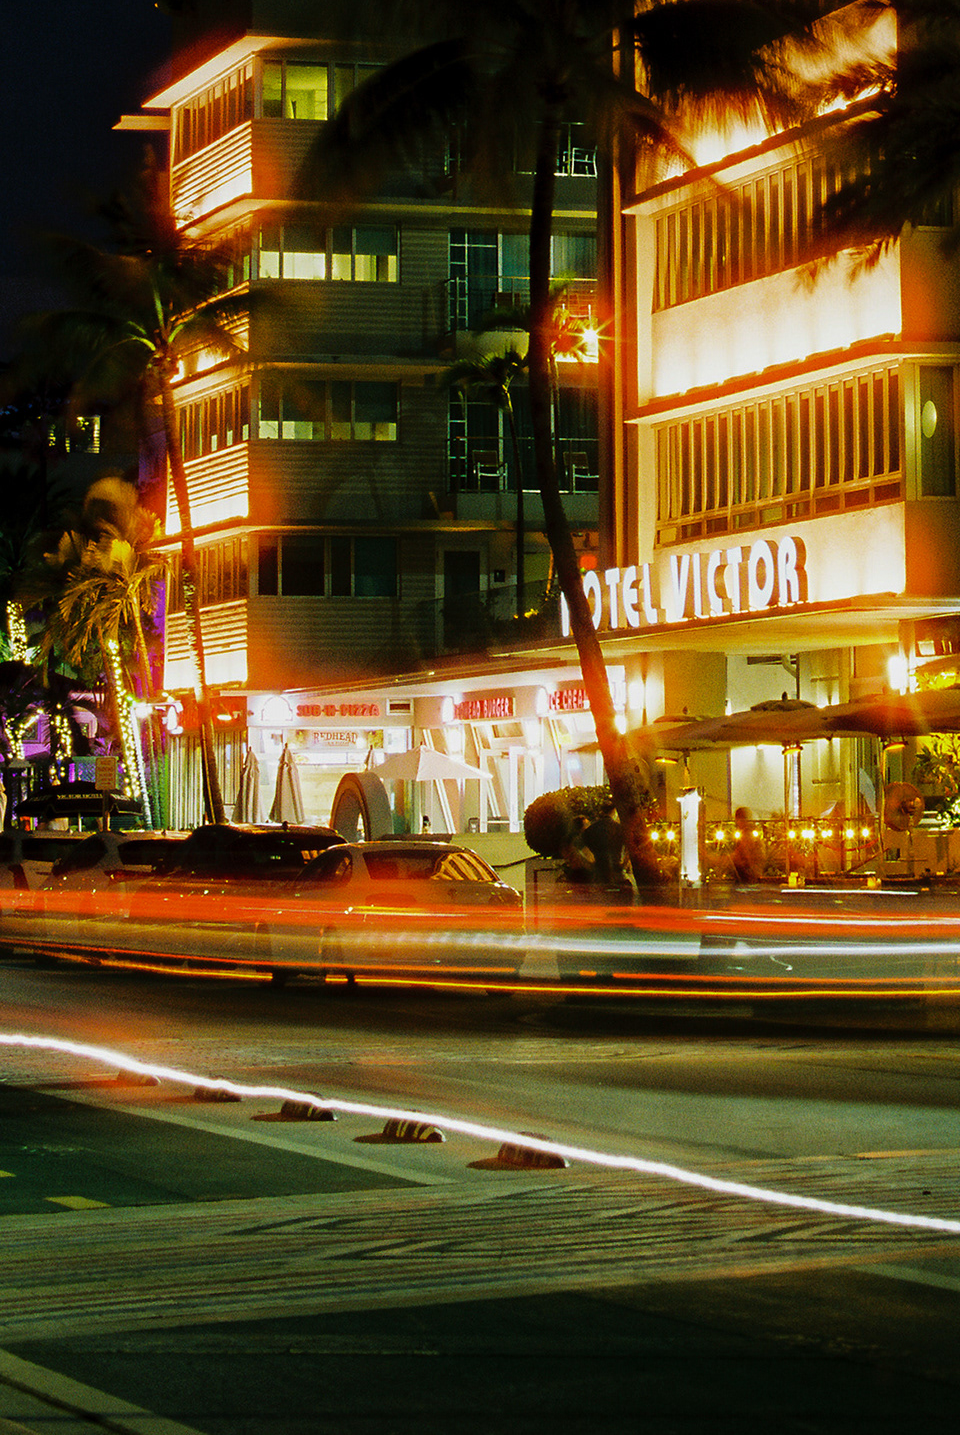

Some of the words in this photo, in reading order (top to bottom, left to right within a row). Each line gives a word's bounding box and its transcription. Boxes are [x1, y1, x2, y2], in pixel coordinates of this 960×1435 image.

[669, 536, 801, 623] VICTOR
[484, 697, 510, 718] BURGER
[549, 691, 560, 710] ICE
[313, 731, 358, 745] REDHEAD
